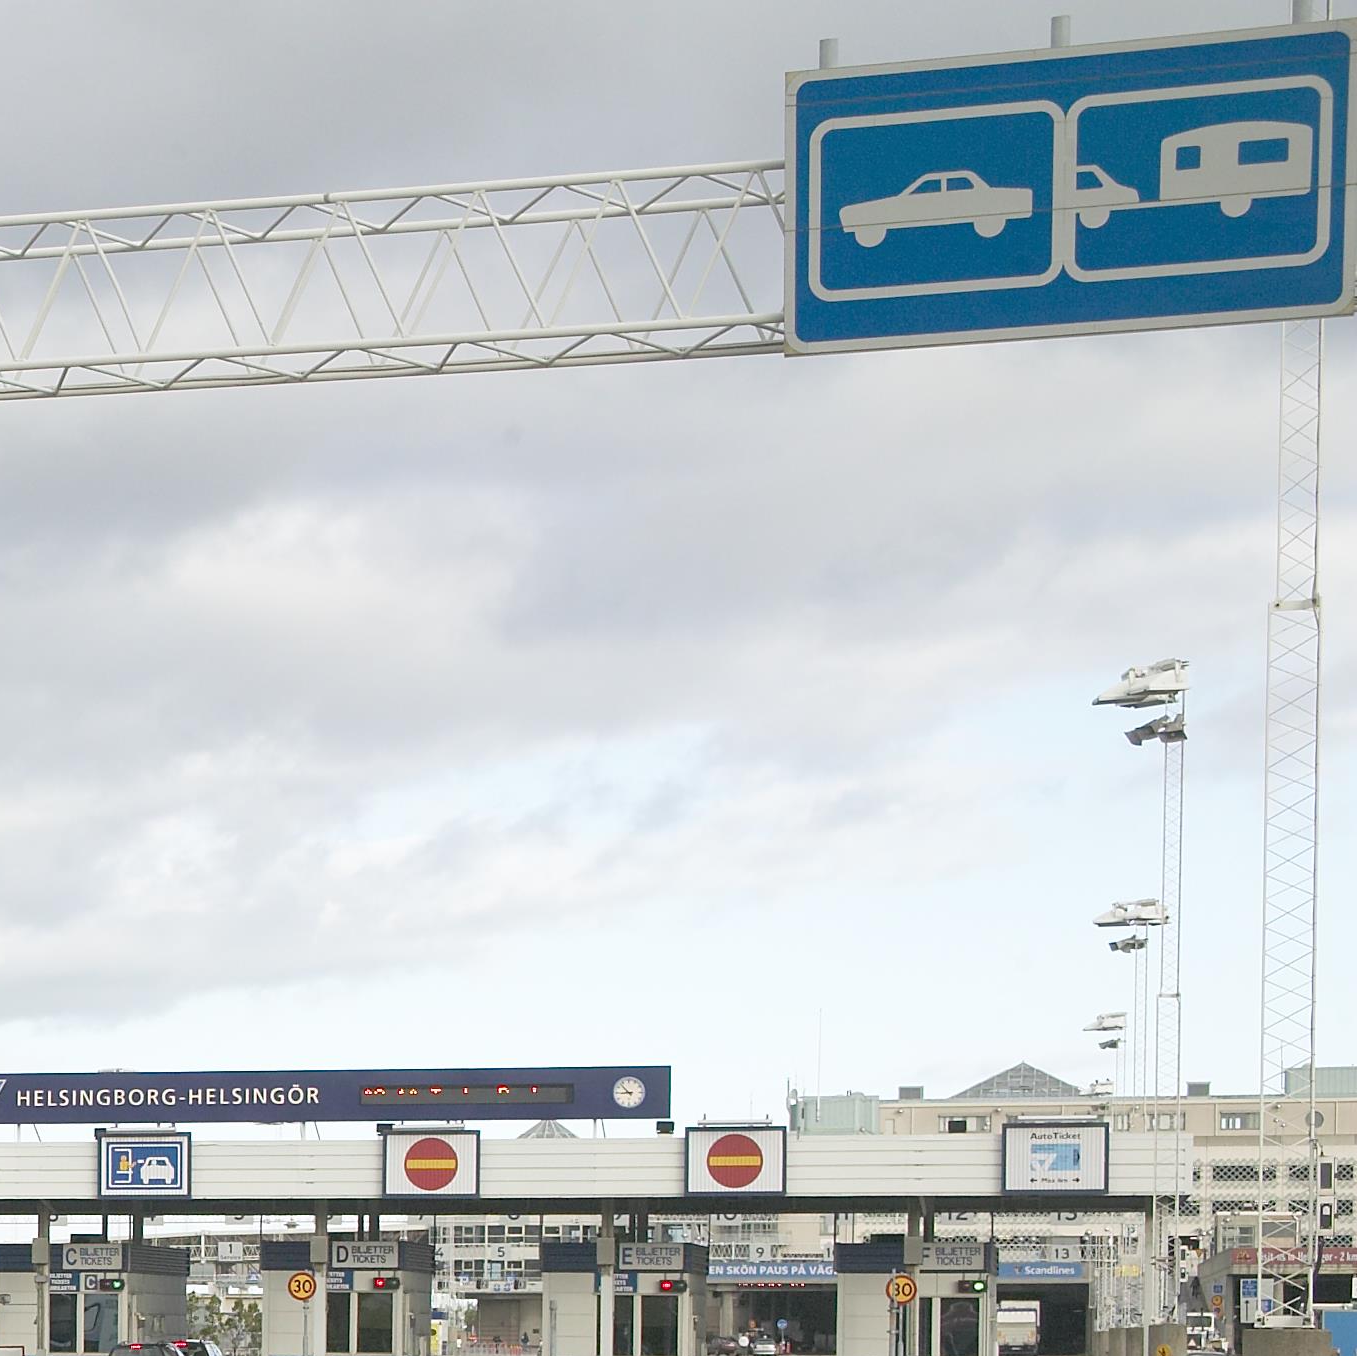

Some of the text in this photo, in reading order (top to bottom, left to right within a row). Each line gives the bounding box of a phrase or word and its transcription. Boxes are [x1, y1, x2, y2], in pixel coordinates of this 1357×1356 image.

[15, 1084, 321, 1107] HELSINGBORG-HELSINGÖR
[65, 1247, 120, 1266] C BILJETTER
[336, 1245, 395, 1264] D BILJETTER
[497, 1246, 506, 1258] 5
[622, 1247, 681, 1265] E BILJETTER
[755, 1247, 765, 1258] 9
[935, 1246, 981, 1256] BILJETTER
[1054, 1248, 1070, 1259] 13
[80, 1256, 113, 1266] TICKETS
[352, 1254, 387, 1264] TICKETS
[636, 1256, 673, 1266] TICKETS
[936, 1256, 973, 1266] TICKETS
[708, 1265, 724, 1275] EN
[726, 1262, 757, 1275] SKÖN
[759, 1265, 789, 1275] PAUS
[791, 1263, 807, 1275] PÅ
[1024, 1265, 1075, 1275] Scandlines
[85, 1275, 96, 1288] C
[293, 1279, 313, 1294] 30
